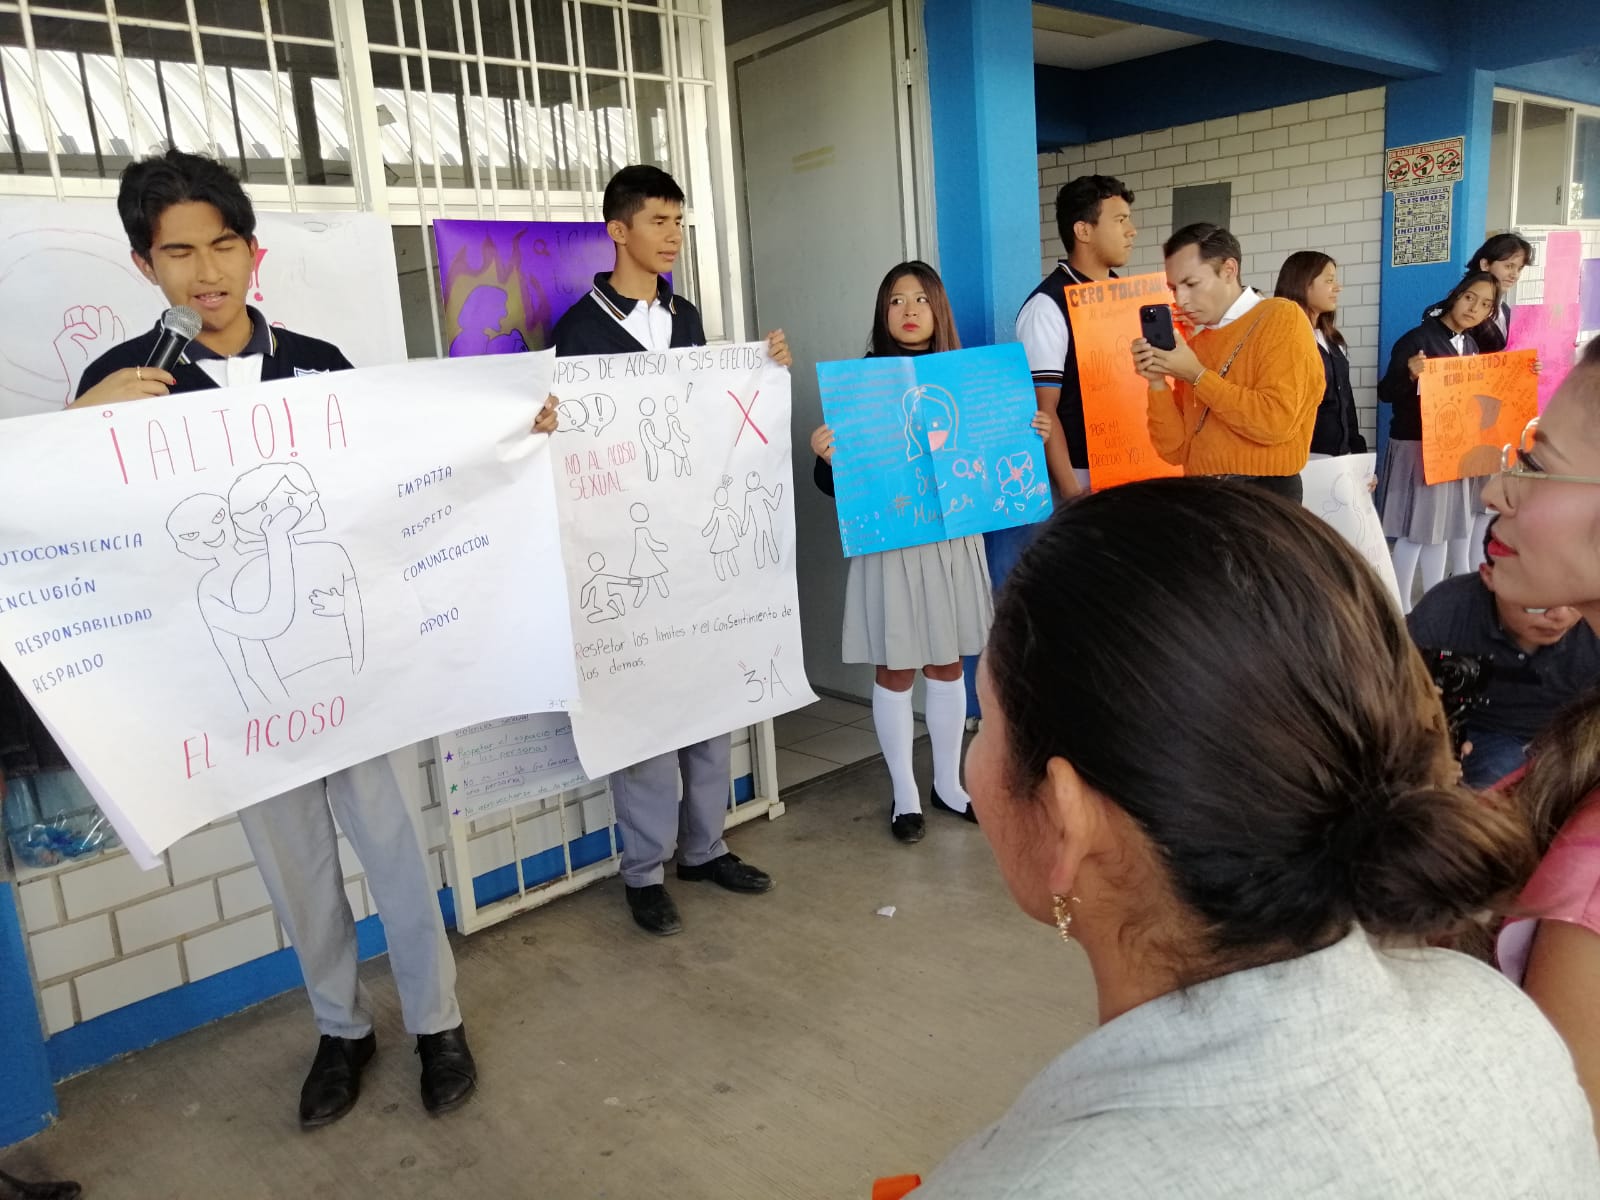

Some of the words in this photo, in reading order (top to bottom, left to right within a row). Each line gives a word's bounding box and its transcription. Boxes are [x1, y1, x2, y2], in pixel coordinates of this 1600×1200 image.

[1400, 193, 1445, 204] SISMOS
[1397, 223, 1447, 234] INCENDIOS
[1069, 286, 1104, 307] CERO
[553, 360, 590, 385] IPOS
[599, 356, 616, 380] DE
[625, 353, 666, 377] ACOSO
[676, 355, 684, 371] Y
[688, 350, 714, 371] SUS
[720, 347, 762, 370] EFECTOS
[327, 393, 347, 449] A
[565, 452, 581, 475] NO
[588, 450, 605, 471] AL
[608, 441, 637, 468] ACOSO
[569, 469, 630, 501] SEXUAL
[401, 504, 453, 538] RESPETO
[15, 608, 153, 657] RESPONSABILIDAD
[420, 607, 459, 635] APOYO
[632, 631, 649, 647] los
[699, 620, 709, 634] el
[782, 604, 792, 617] de
[32, 653, 104, 694] RESPALDO
[183, 731, 217, 779] EL
[246, 695, 345, 757] ACOSO
